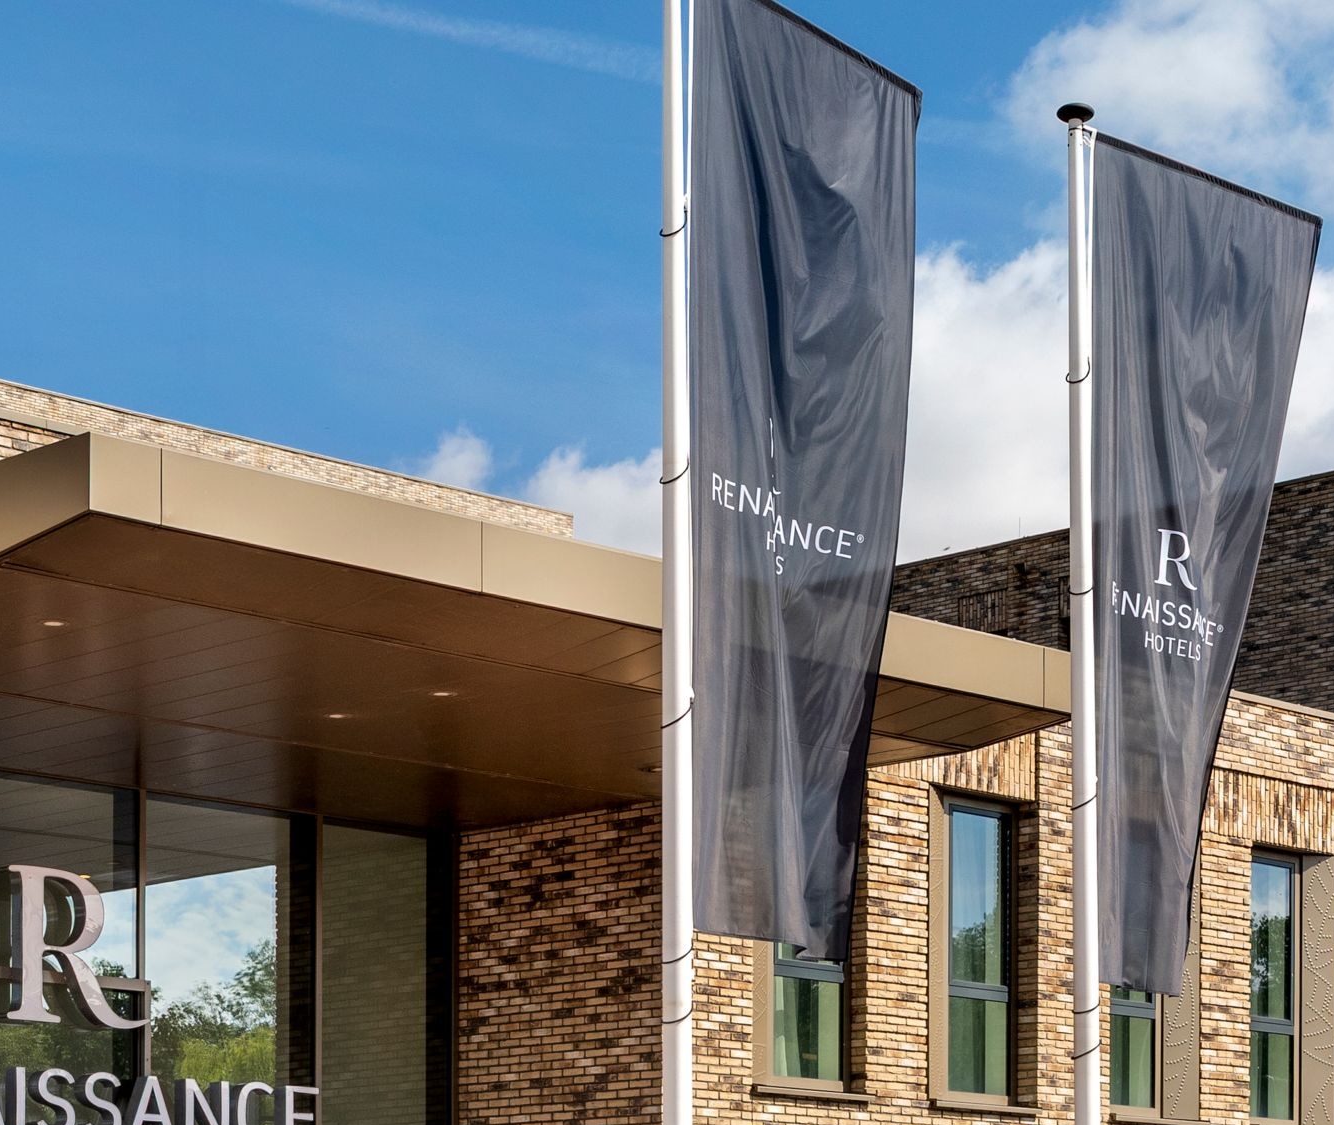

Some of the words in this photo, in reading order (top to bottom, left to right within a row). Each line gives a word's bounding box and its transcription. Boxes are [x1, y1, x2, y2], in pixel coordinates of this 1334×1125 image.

[1154, 528, 1198, 591] R
[1144, 631, 1202, 661] HOTELS
[7, 864, 151, 1030] R
